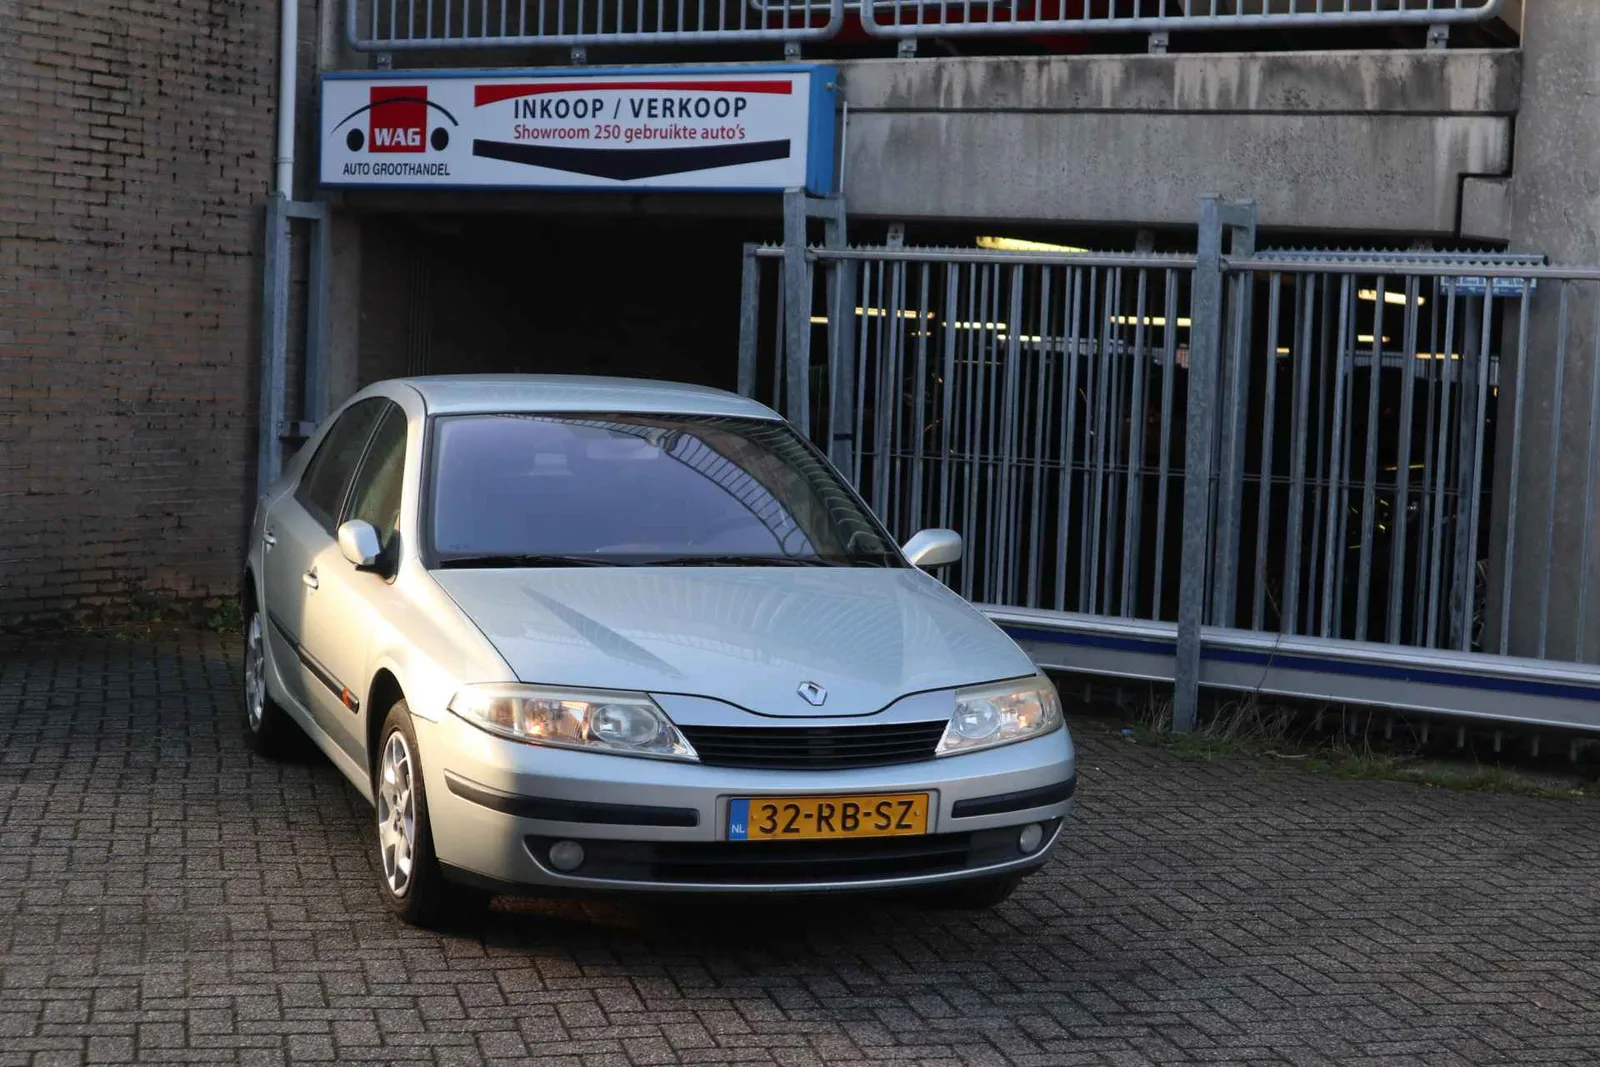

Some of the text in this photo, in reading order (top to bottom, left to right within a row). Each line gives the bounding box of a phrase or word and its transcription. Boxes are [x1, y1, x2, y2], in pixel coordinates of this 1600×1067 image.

[513, 98, 605, 120] INKOOP
[630, 96, 748, 119] VERKOOP
[373, 127, 421, 147] WAG
[513, 122, 746, 143] Showroom 250 gebruikte auto's
[342, 162, 451, 177] AUTO GROOTHANDEL
[759, 800, 915, 835] 32-RB-SZ
[731, 823, 746, 835] NL
